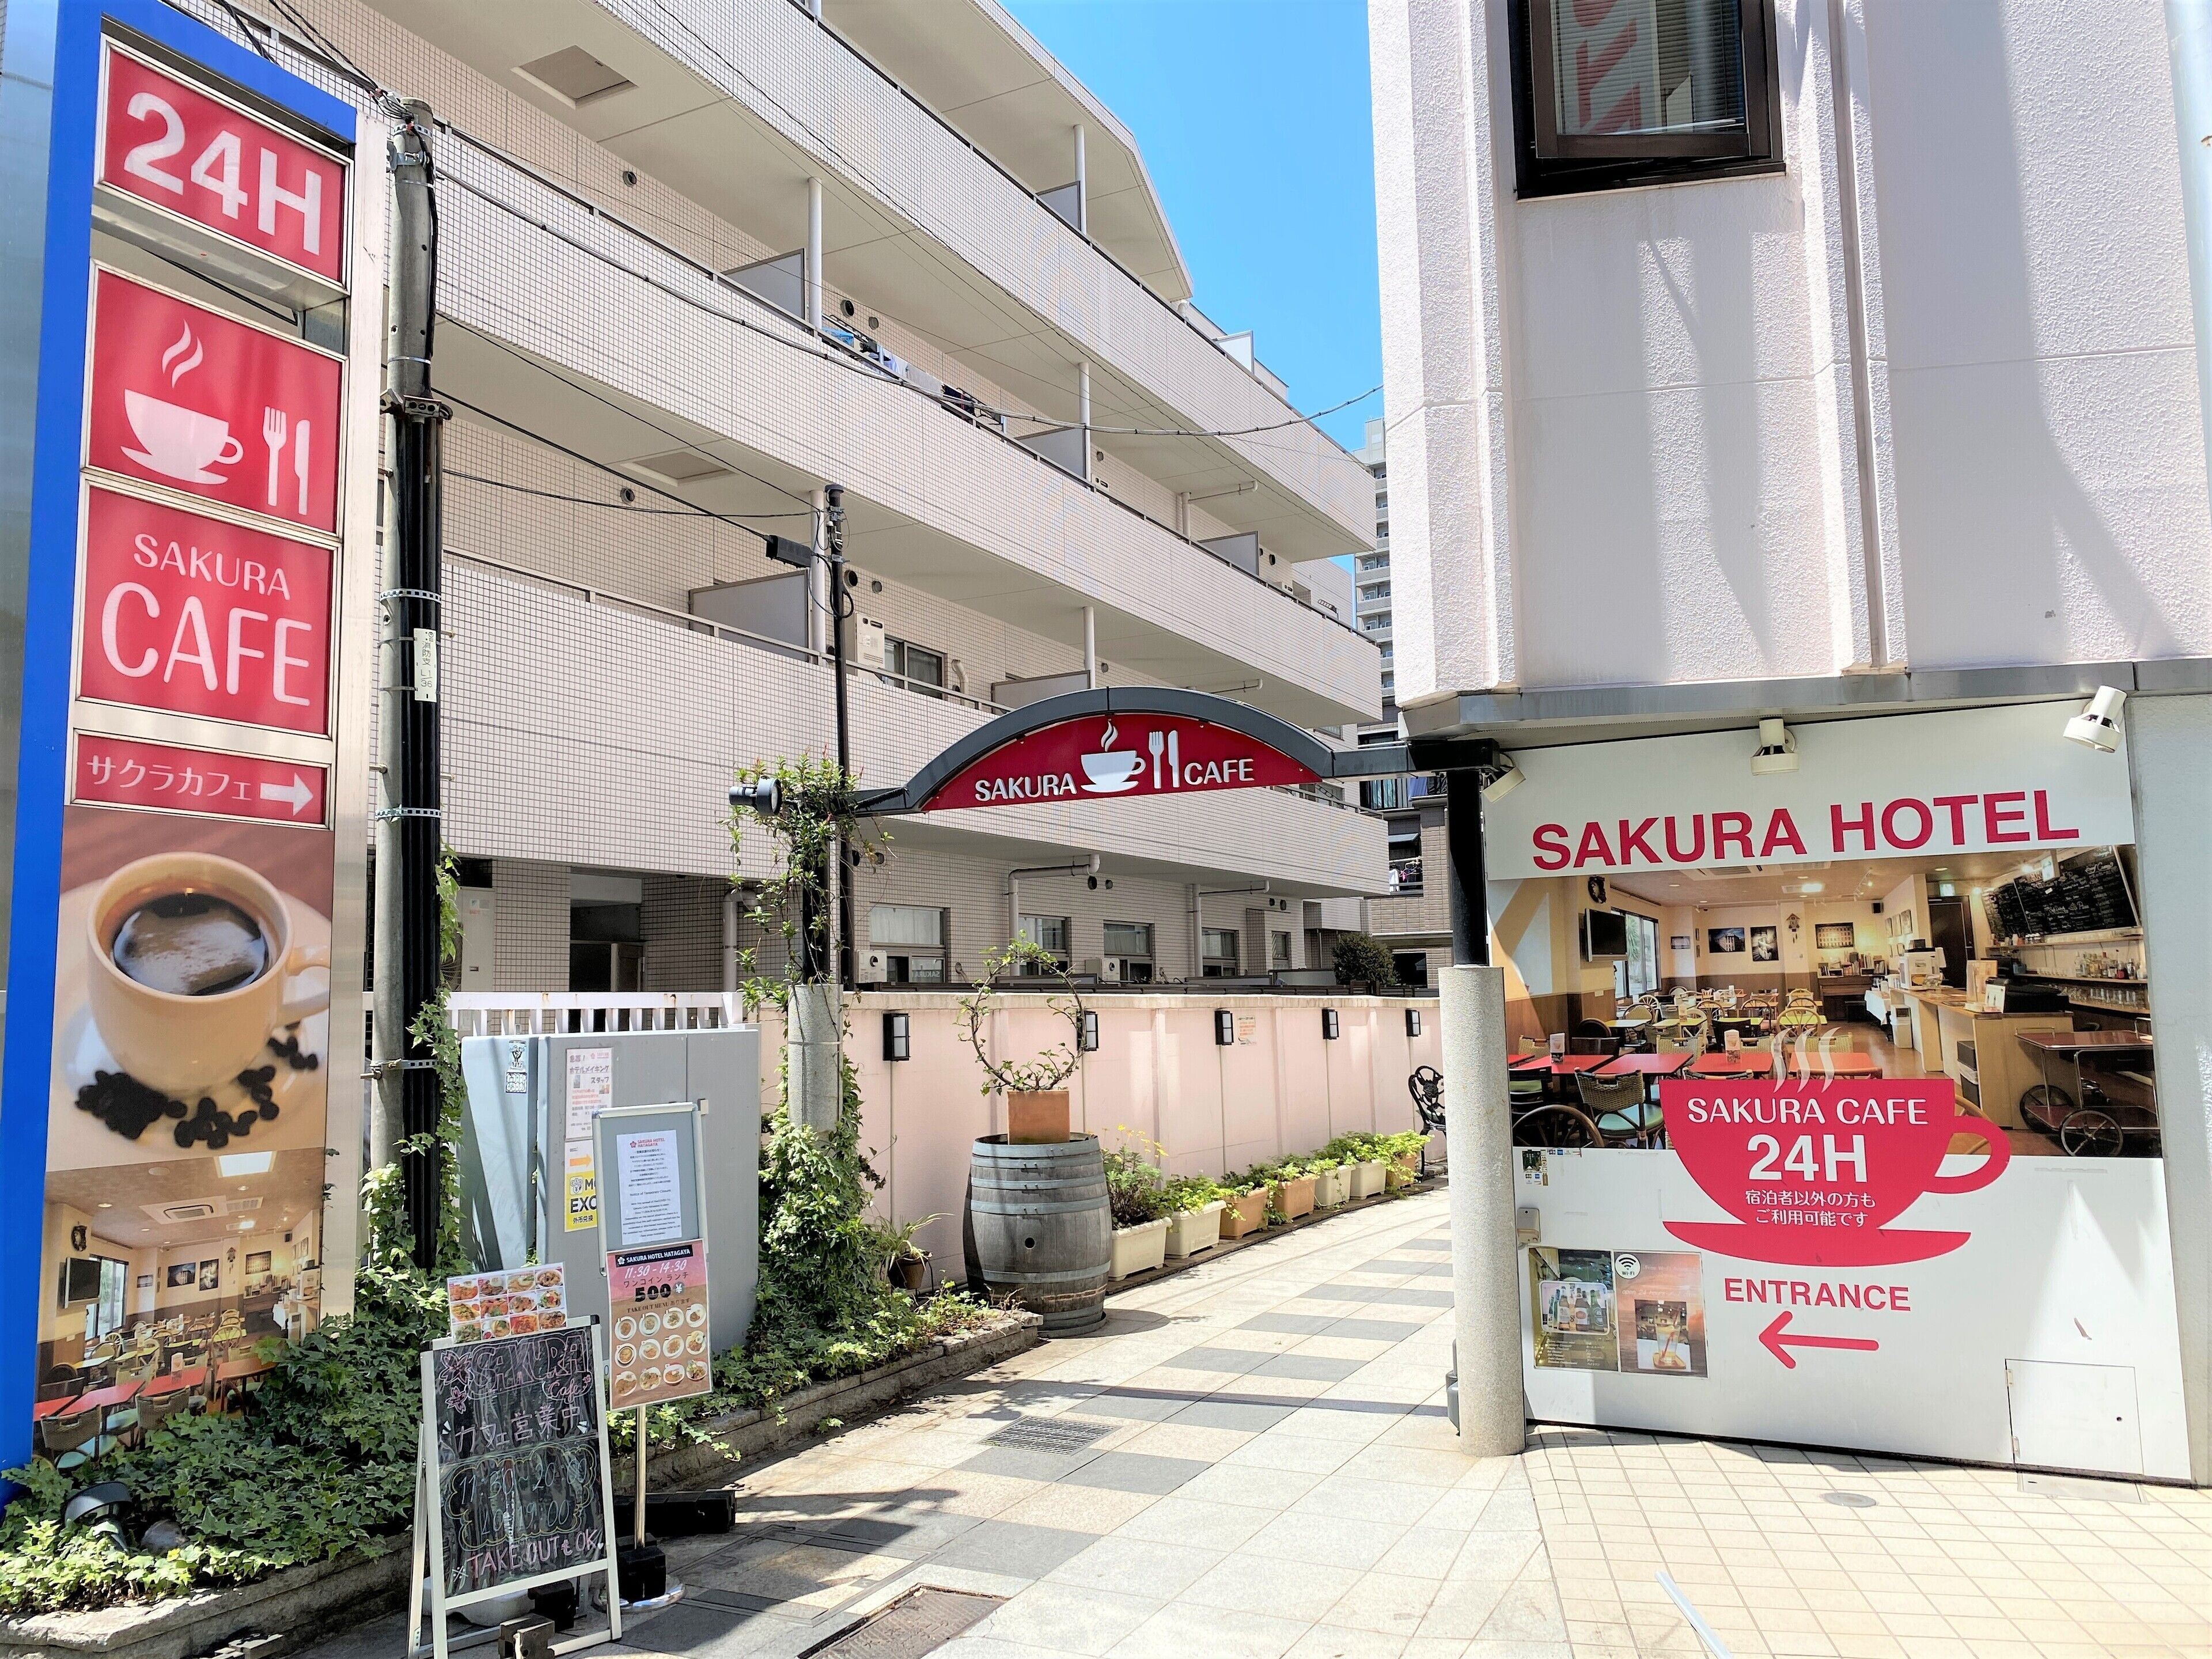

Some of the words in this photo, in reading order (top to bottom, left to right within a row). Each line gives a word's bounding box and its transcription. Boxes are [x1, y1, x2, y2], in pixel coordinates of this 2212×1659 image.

[123, 91, 322, 256] 24H
[132, 532, 291, 601] SAKURA
[100, 581, 312, 706] CAFE
[87, 755, 252, 801] サクラカフェ
[975, 772, 1077, 801] SAKURA
[1184, 758, 1254, 785] CAFE
[1532, 806, 1808, 870] SAKURA
[1830, 789, 2080, 853] HOTEL
[1687, 1097, 1825, 1124] SAKURA
[1836, 1097, 1929, 1126] CAFE
[1747, 1133, 1868, 1183] 24H
[1745, 1190, 1876, 1208] 宿泊者以外の方も
[1755, 1209, 1869, 1227] ご利用可能です
[624, 1265, 650, 1279] 11:30
[659, 1259, 687, 1274] 14:30
[664, 1248, 691, 1258] HATAGAYA
[623, 1276, 662, 1288] ワンコイン
[666, 1272, 689, 1281] ランチ
[635, 1283, 671, 1302] 500
[1724, 1278, 1911, 1312] ENTRANCE
[471, 1335, 587, 1391] SAKURA
[456, 1404, 581, 1453] カフェ営業中
